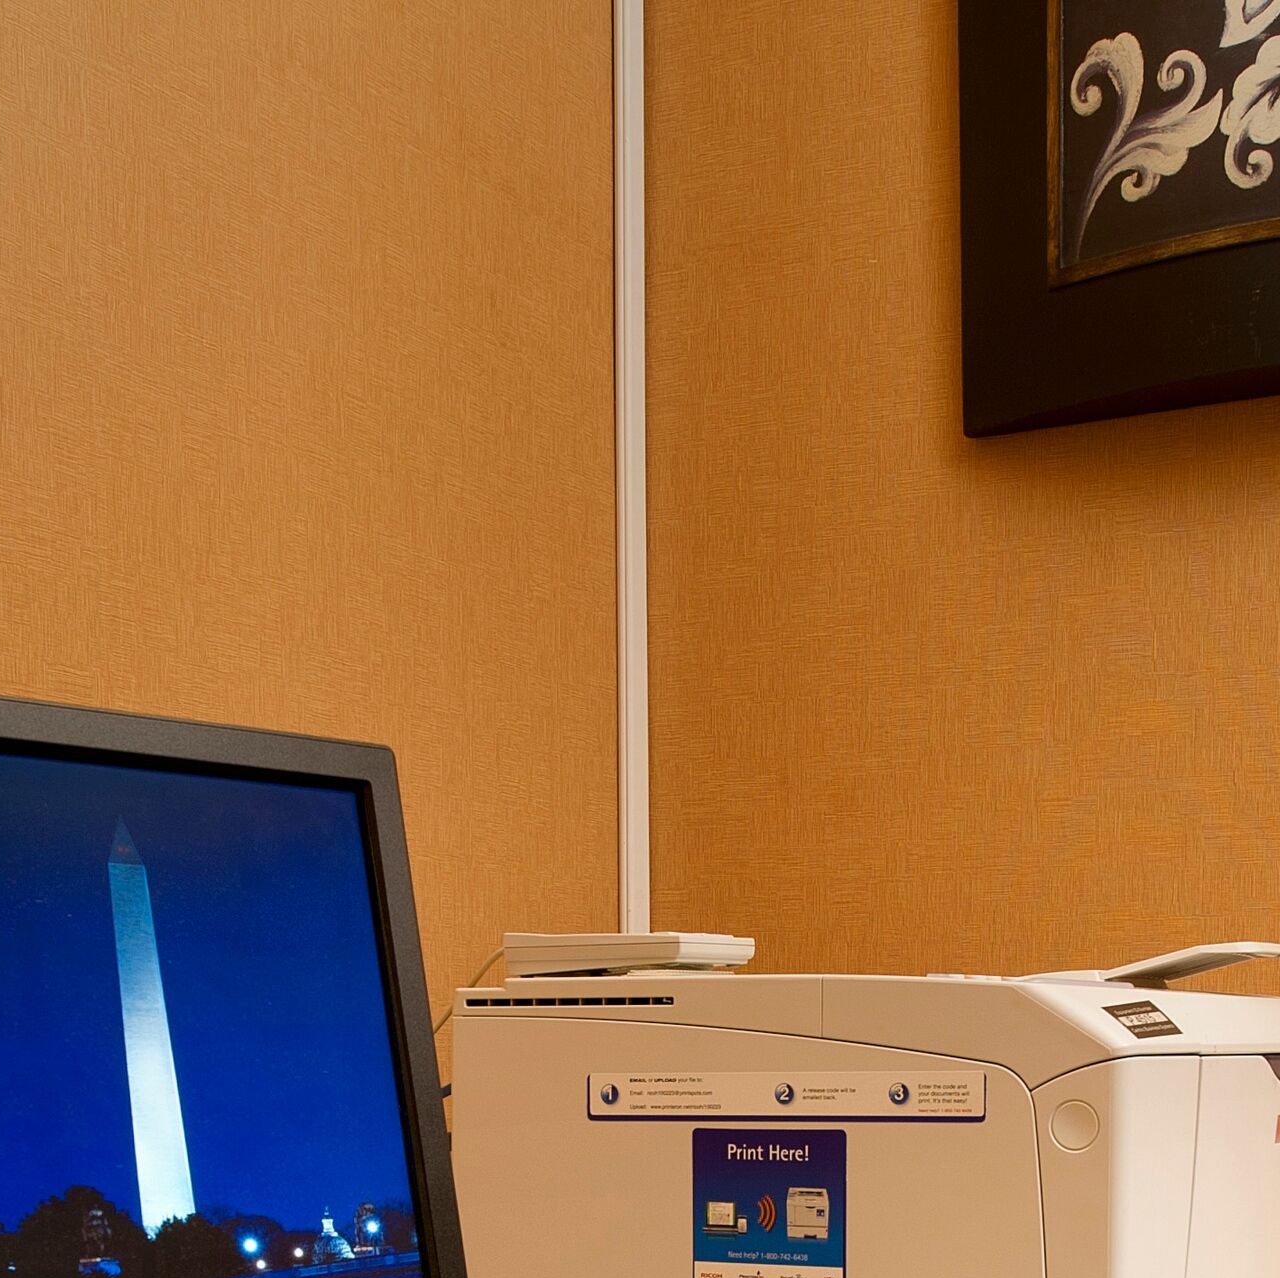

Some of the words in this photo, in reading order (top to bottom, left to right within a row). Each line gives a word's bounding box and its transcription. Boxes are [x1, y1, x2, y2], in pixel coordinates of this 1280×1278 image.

[727, 1143, 764, 1162] Print
[769, 1144, 809, 1163] Here!
[743, 1251, 759, 1260] help?
